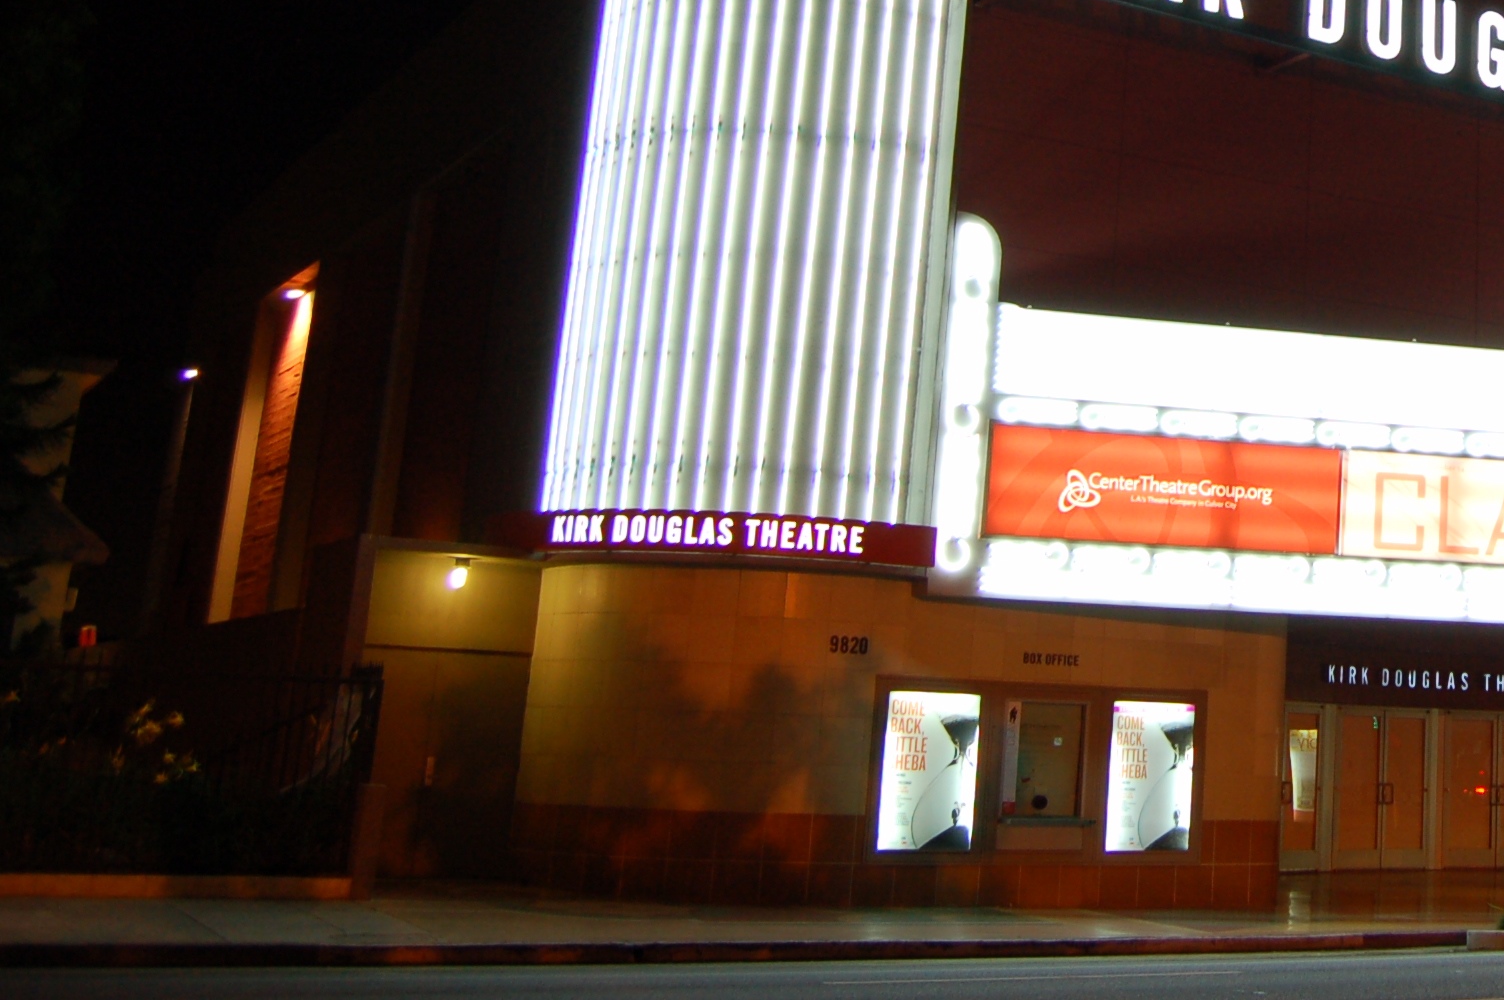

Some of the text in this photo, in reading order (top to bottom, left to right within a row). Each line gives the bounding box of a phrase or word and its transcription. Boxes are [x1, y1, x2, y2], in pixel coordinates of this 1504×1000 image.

[1088, 472, 1273, 506] CenterTheatreGroup.org
[552, 514, 865, 554] KIRK DOUGLAS THEATRE
[829, 635, 869, 655] 9820
[1023, 652, 1079, 667] BOX OFFICE
[1328, 664, 1369, 686] KIRK
[1382, 667, 1470, 691] DOUGLAS
[892, 699, 925, 716] COME
[891, 717, 925, 736] BACK,
[1117, 715, 1145, 730] COME
[894, 736, 928, 753] ITTLE
[893, 754, 926, 771] HEBA
[1117, 748, 1148, 763] ITTLE
[1119, 764, 1148, 779] HEBA
